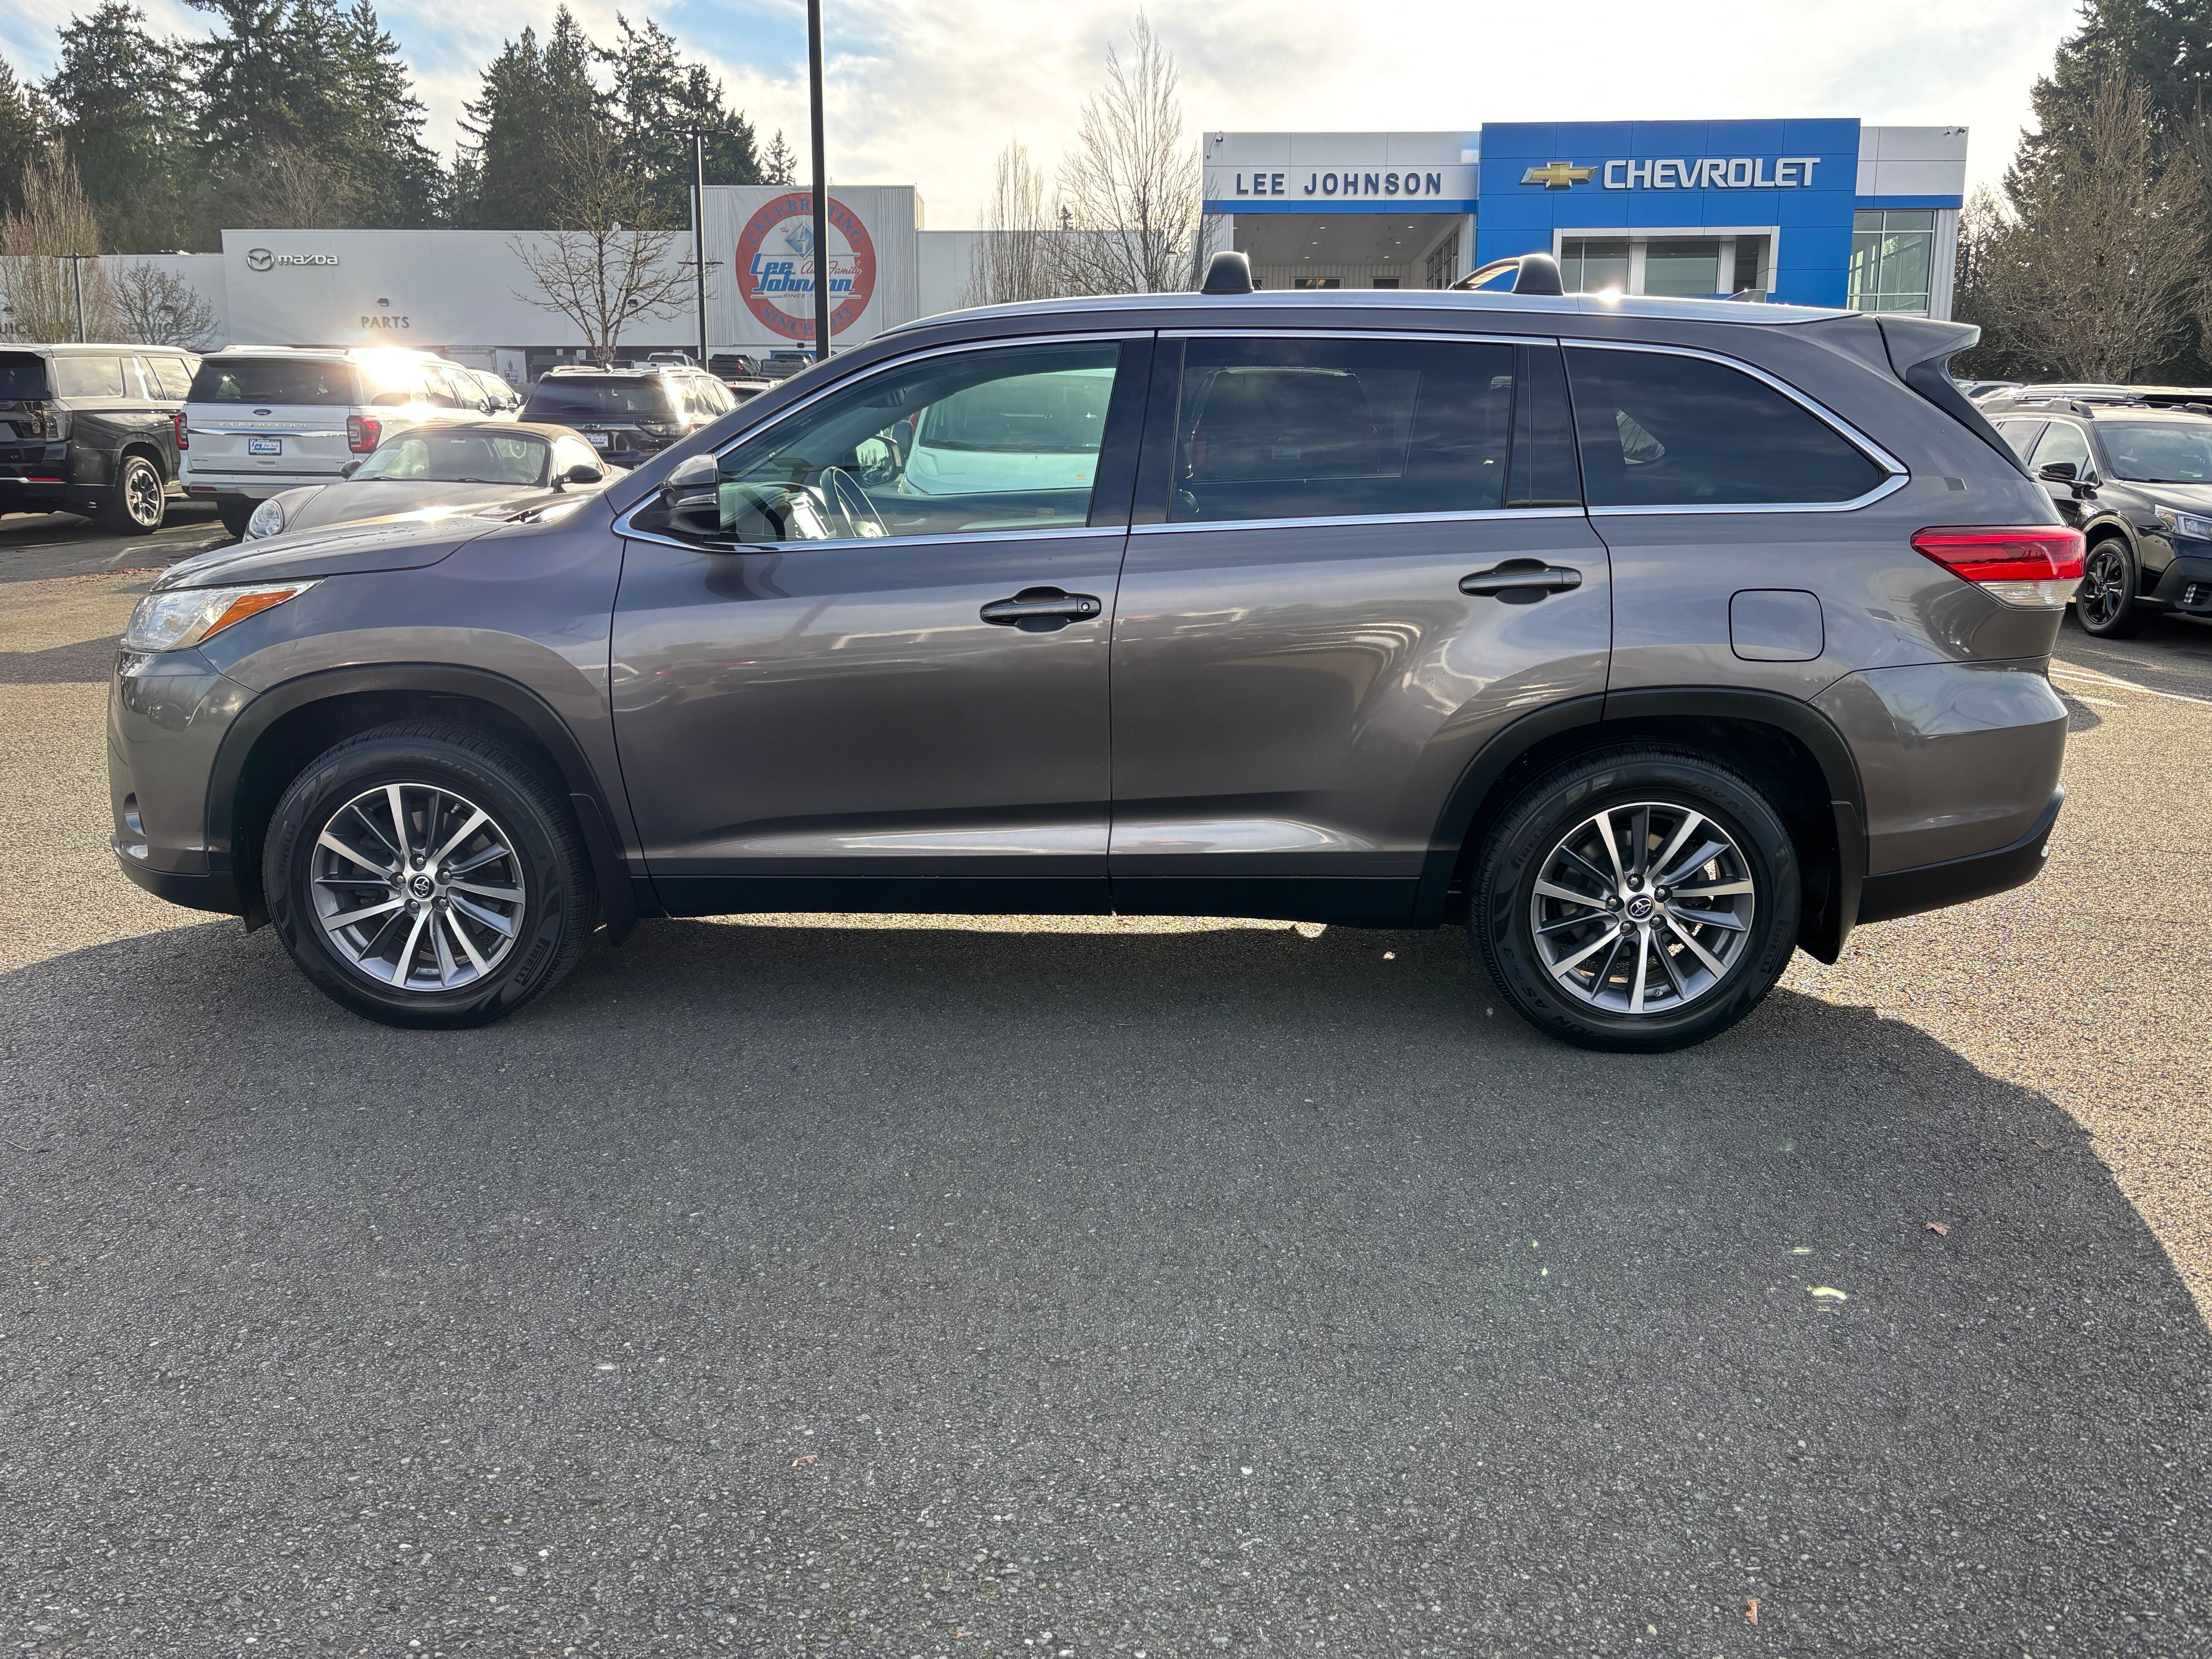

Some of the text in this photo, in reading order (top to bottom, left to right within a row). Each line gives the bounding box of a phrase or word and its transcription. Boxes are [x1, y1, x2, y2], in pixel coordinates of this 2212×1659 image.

[1236, 173, 1442, 194] LEE JOHNSON
[1603, 157, 1821, 189] CHEVROLET
[747, 198, 864, 244] CELEBRTING
[750, 253, 796, 275] Lee
[361, 316, 410, 328] PARTS
[761, 306, 814, 336] SINCE
[514, 936, 551, 986] PIRELLI
